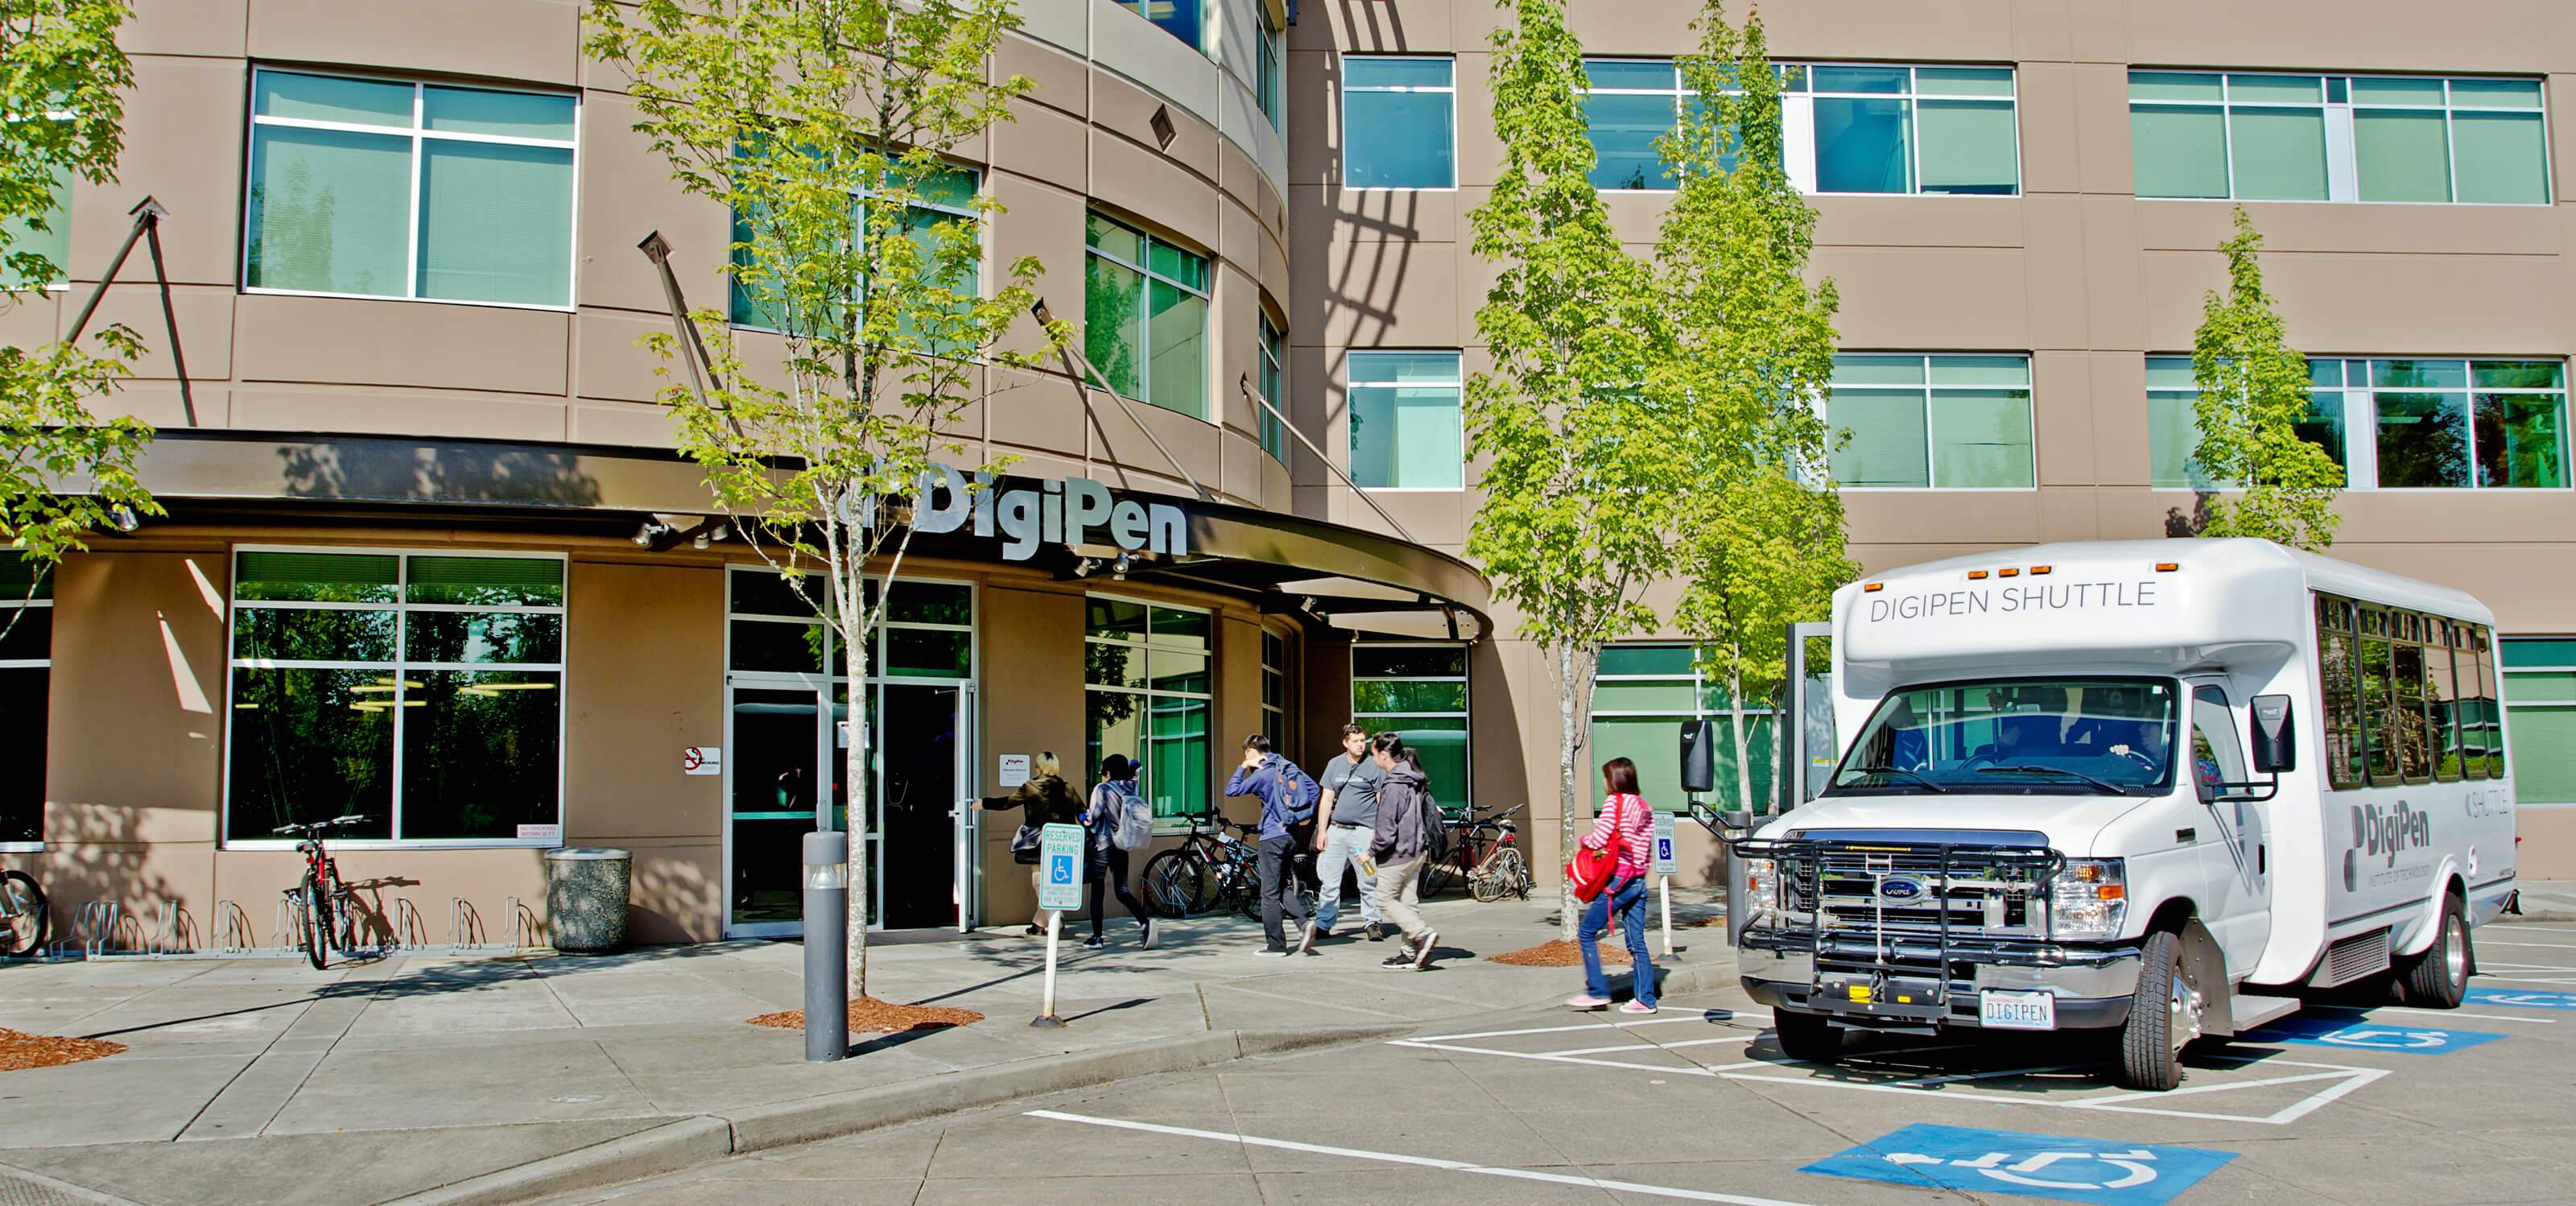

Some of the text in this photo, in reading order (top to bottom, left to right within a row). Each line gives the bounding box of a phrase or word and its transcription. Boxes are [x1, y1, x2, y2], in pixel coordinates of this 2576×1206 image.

[915, 461, 1187, 561] DigiPen
[1871, 581, 2157, 622] DIGIPEN SHUTTLE
[1046, 830, 1081, 843] RESERVED
[2364, 799, 2430, 869] DigiPen
[1046, 843, 1080, 856] PARKING
[1987, 1003, 2047, 1022] DIGIPEN
